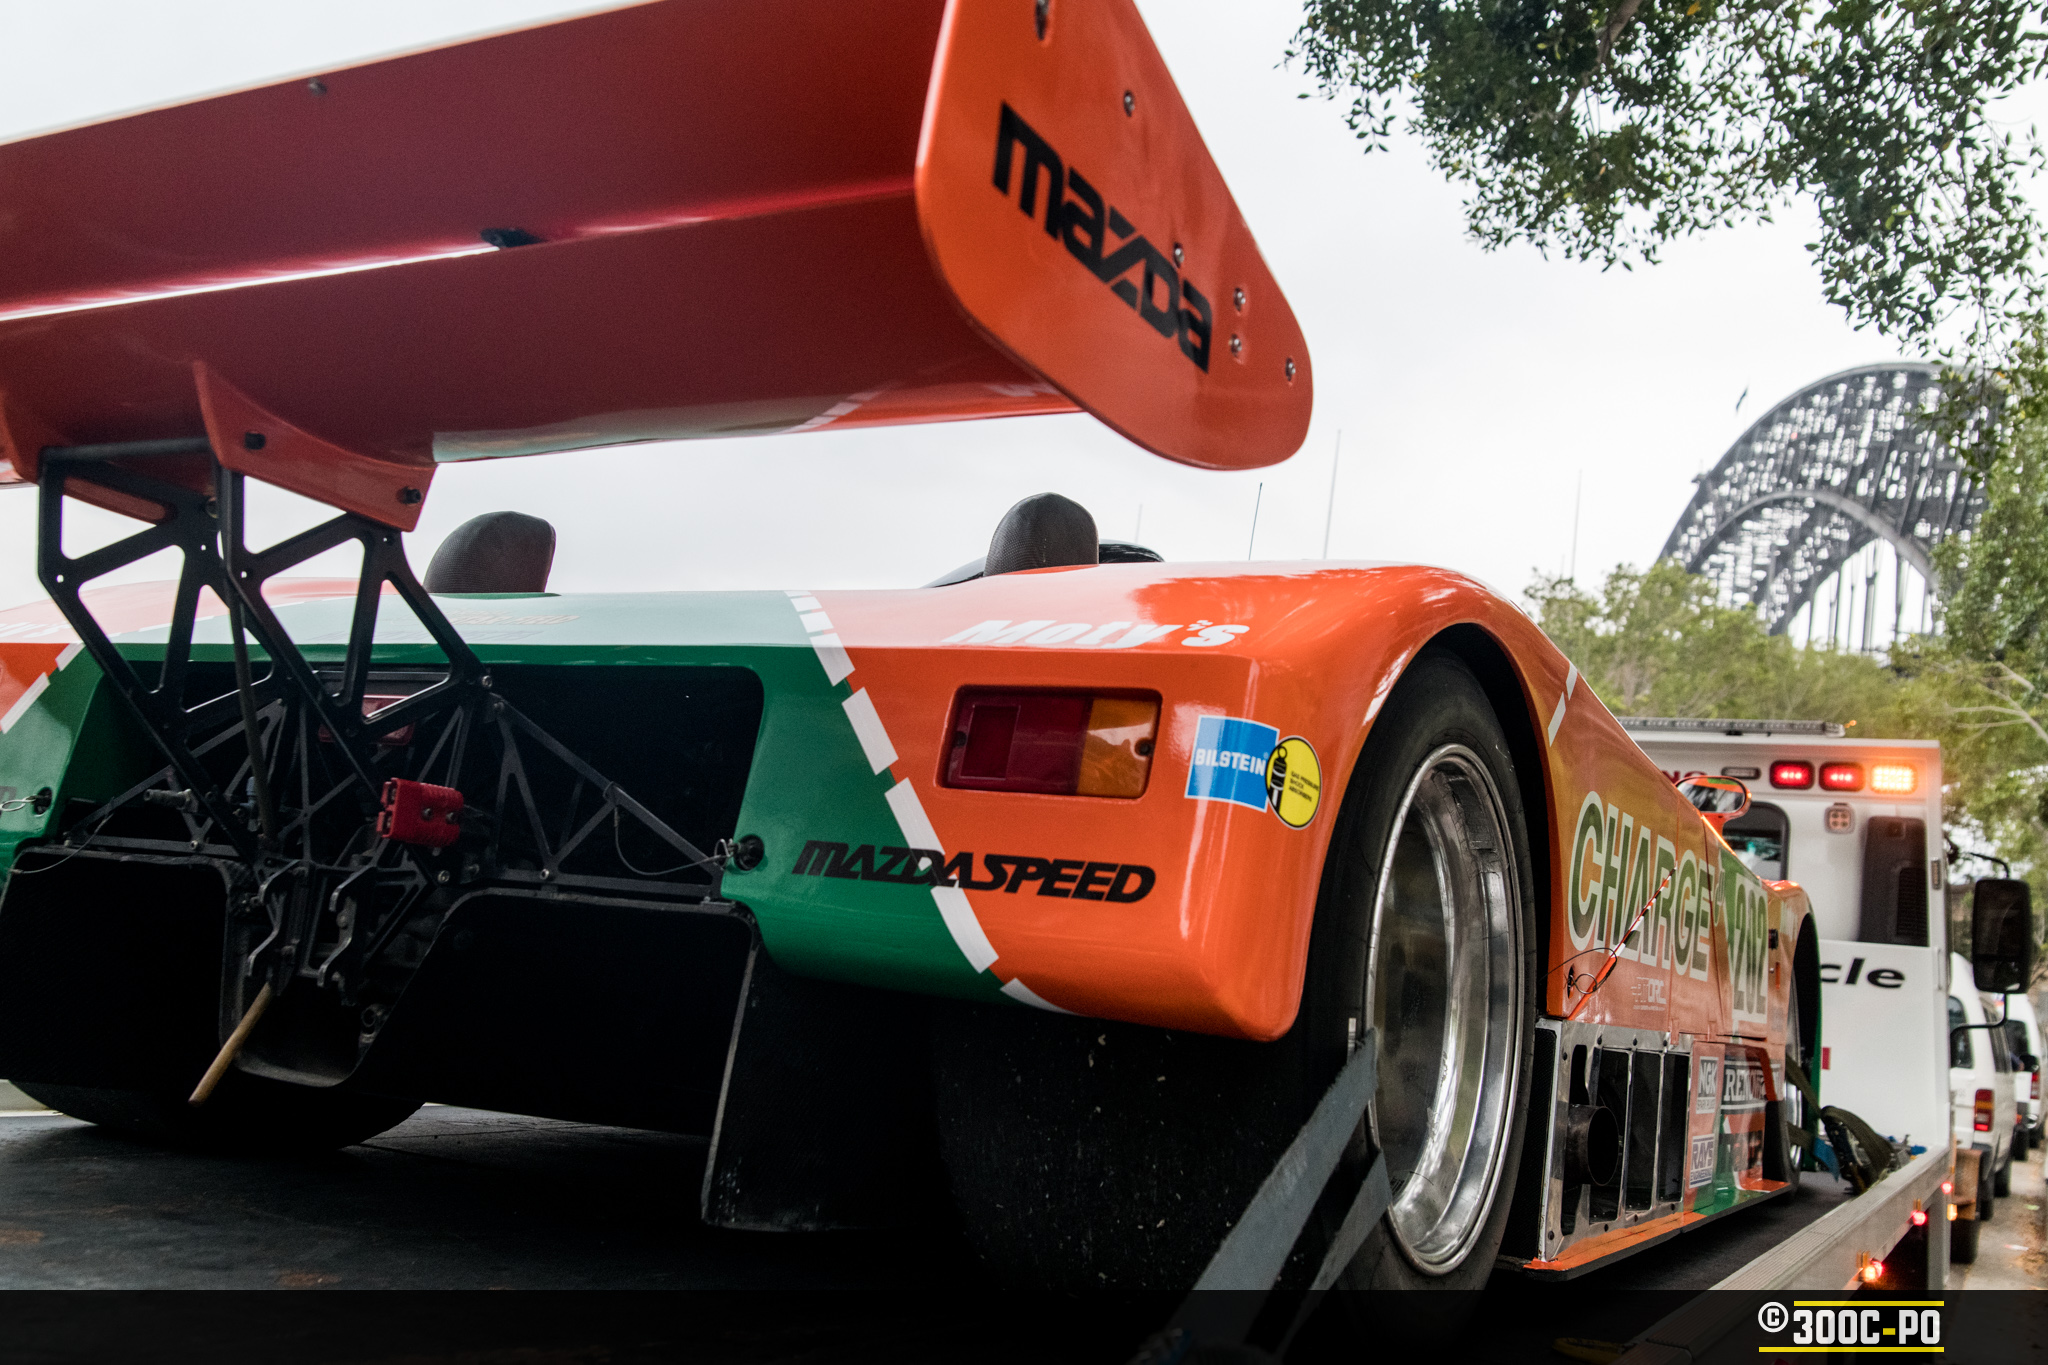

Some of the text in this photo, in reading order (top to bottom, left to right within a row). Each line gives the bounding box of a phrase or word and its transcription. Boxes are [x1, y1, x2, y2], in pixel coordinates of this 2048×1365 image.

[941, 619, 1250, 649] Moty's
[1194, 748, 1267, 776] BILSTEIN
[791, 840, 1156, 903] MAZDASPEED
[1568, 791, 1715, 981] CHARGE
[1698, 1062, 1718, 1094] NGK
[1691, 1141, 1713, 1170] RAYS
